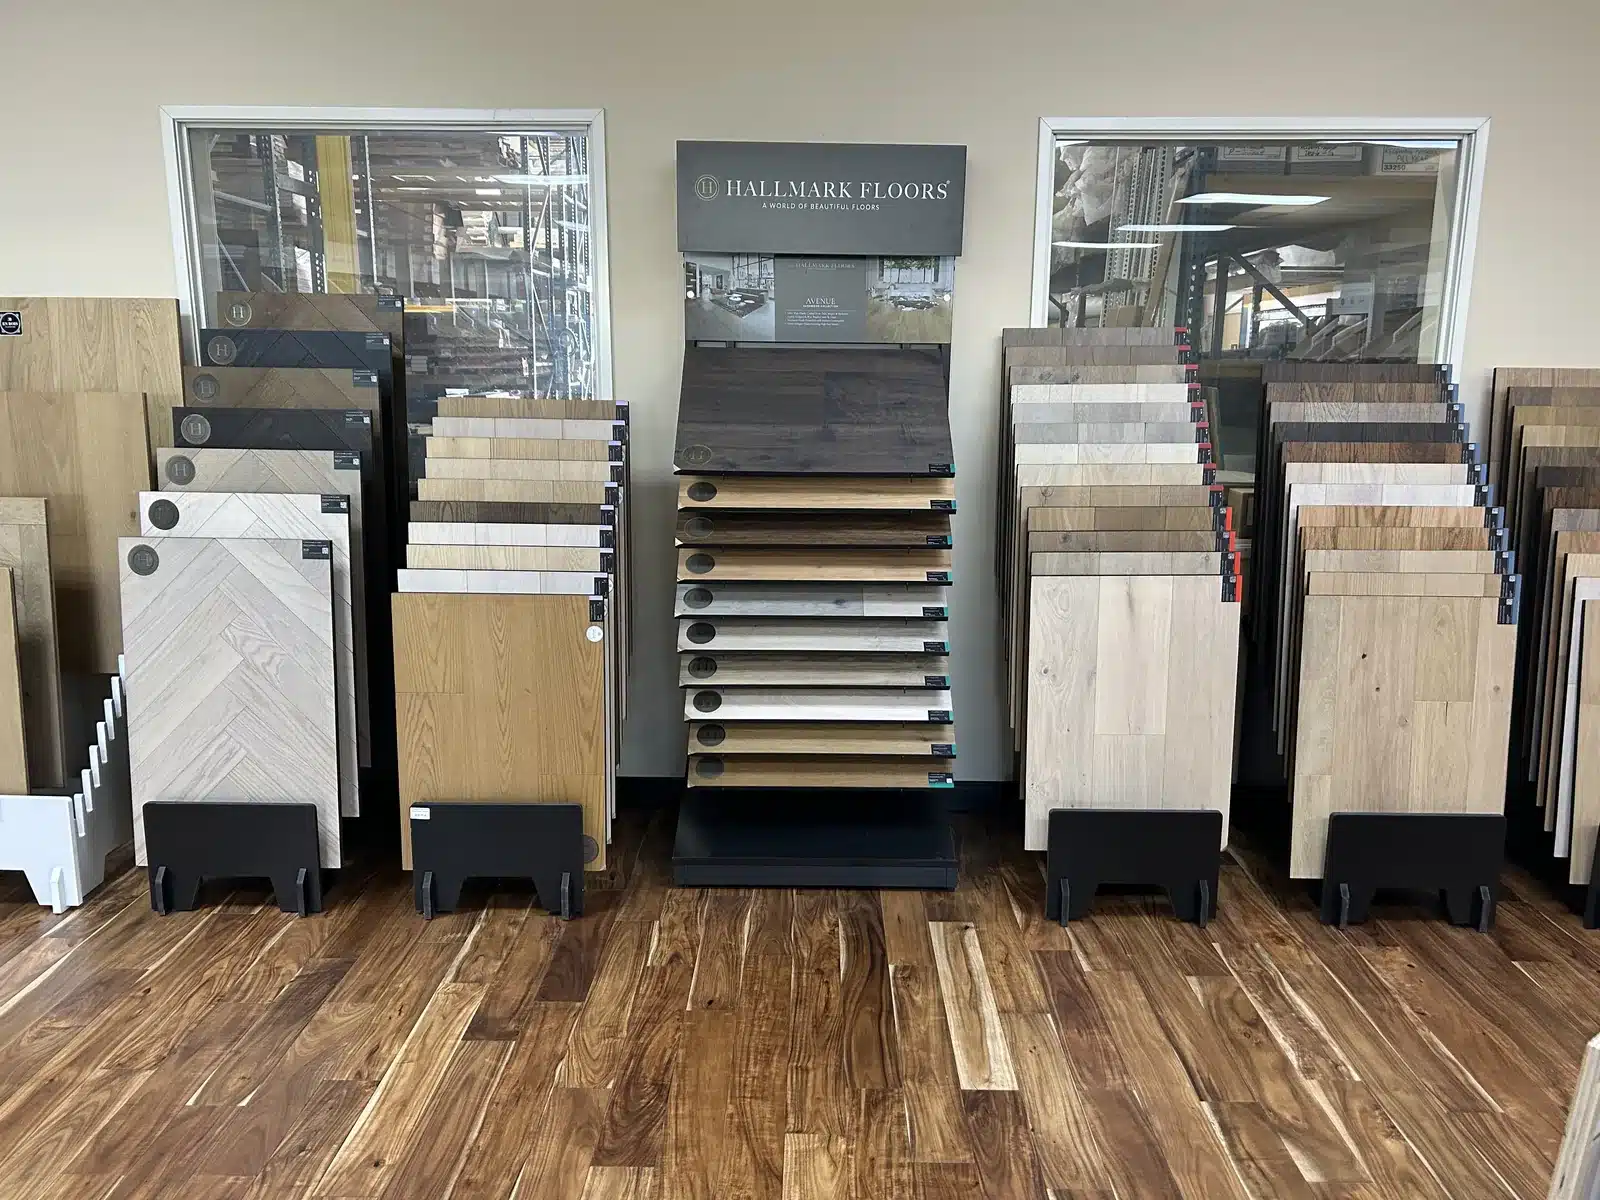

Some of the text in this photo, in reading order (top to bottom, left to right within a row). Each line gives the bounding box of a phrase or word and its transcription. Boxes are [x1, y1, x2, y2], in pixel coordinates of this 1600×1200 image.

[726, 179, 948, 200] HALLMARK FLOORS
[769, 202, 796, 210] WORLD
[810, 203, 850, 211] BEAUTIFUL
[851, 203, 880, 211] FLOORS
[805, 297, 837, 305] AVENUE
